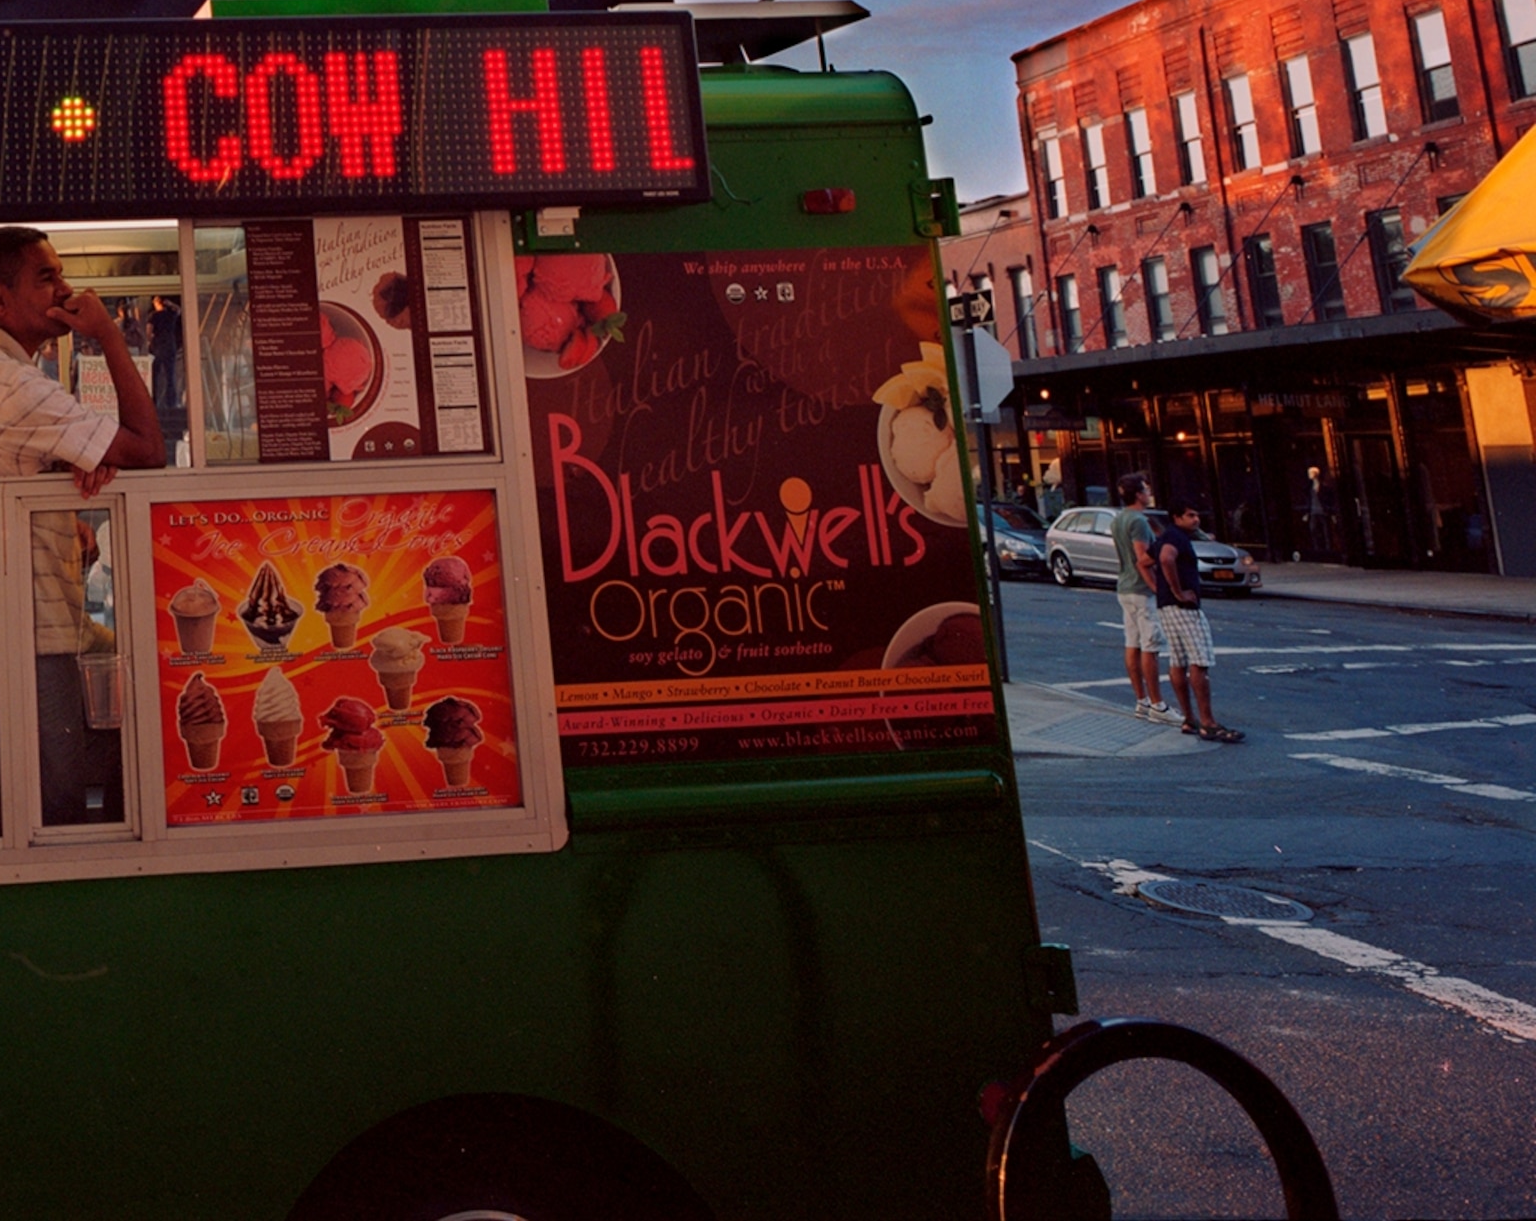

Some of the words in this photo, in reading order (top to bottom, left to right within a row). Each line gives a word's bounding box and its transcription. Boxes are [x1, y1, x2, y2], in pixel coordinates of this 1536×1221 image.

[166, 51, 402, 181] COW
[683, 261, 705, 275] We
[708, 260, 737, 277] ship
[741, 259, 806, 276] anywhere
[823, 258, 837, 271] in
[841, 256, 862, 270] the
[865, 255, 907, 270] U.S.A.
[568, 320, 718, 426] Italian
[1258, 392, 1312, 408] HELMUT
[548, 413, 927, 583] Blackwell's
[336, 498, 455, 534] Organic
[191, 530, 245, 562] Ice
[257, 526, 359, 560] Cream
[590, 579, 830, 676] Organic
[629, 650, 654, 666] soy
[657, 646, 704, 665] gelato
[718, 643, 732, 660] &
[737, 642, 770, 661] fruit
[774, 641, 833, 657] sorbetto
[559, 690, 600, 703] Lemon
[611, 687, 654, 702] Mango
[666, 684, 732, 699] Strawberry
[743, 679, 802, 694] Chocolate
[815, 677, 855, 691] Peanut
[858, 674, 892, 688] Butter
[895, 672, 953, 687] Chocolate
[954, 669, 986, 683] Swirl
[563, 714, 667, 731] Award-Winning
[682, 711, 745, 726] Delicious
[760, 707, 814, 723] Organic
[829, 704, 866, 719] Dairy
[870, 702, 899, 716] Free
[913, 698, 958, 713] Gluten
[962, 697, 990, 711] Free
[578, 736, 700, 757] 732.229.8899
[737, 724, 980, 751] www.blackwellsorganic.com
